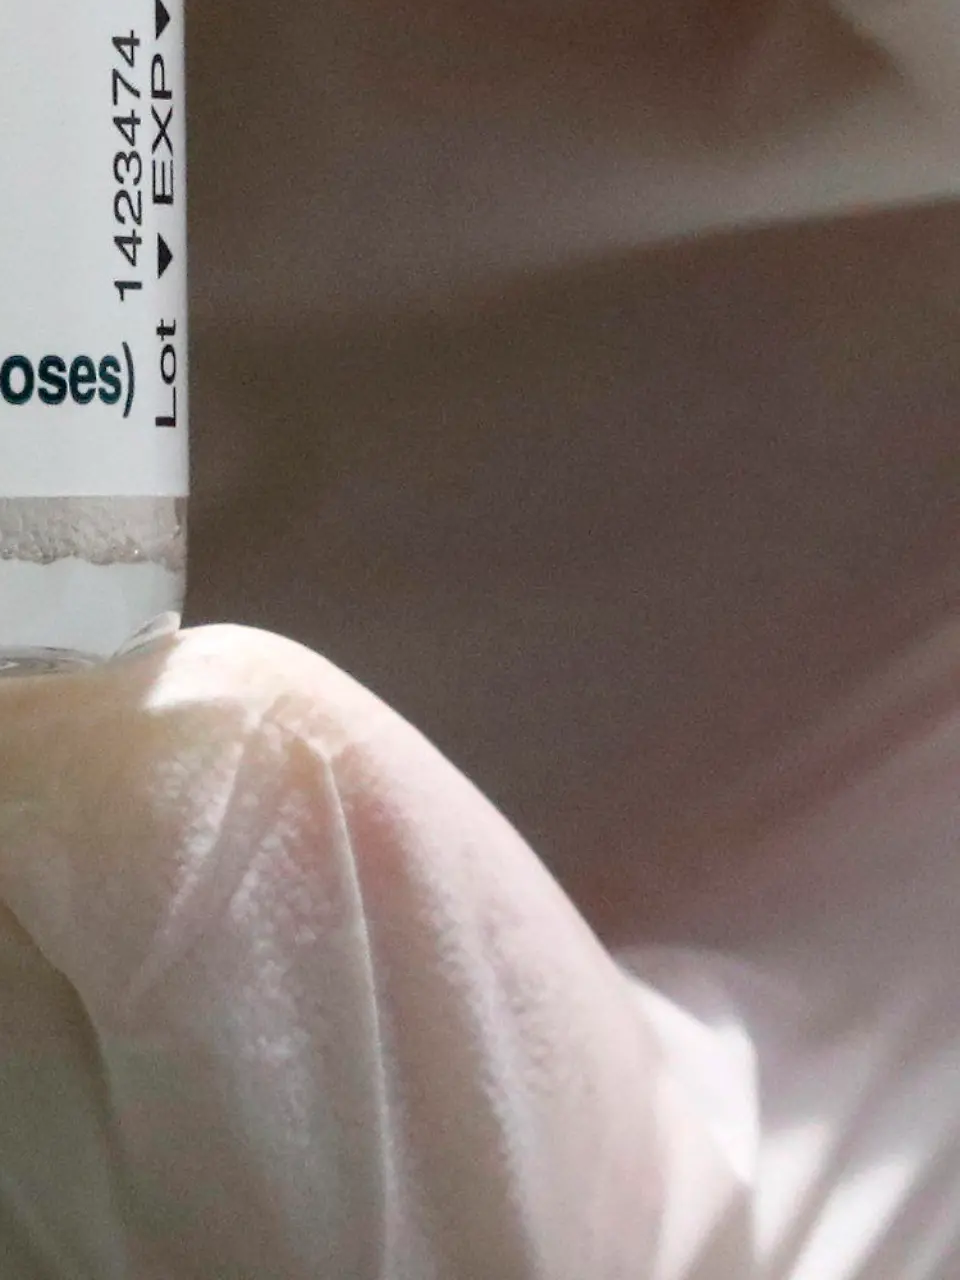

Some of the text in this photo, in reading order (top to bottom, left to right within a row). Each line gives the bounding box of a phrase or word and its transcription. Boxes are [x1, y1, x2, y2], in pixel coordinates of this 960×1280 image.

[111, 29, 143, 303] 1423474
[150, 52, 175, 206] EXP
[154, 317, 178, 429] Lot
